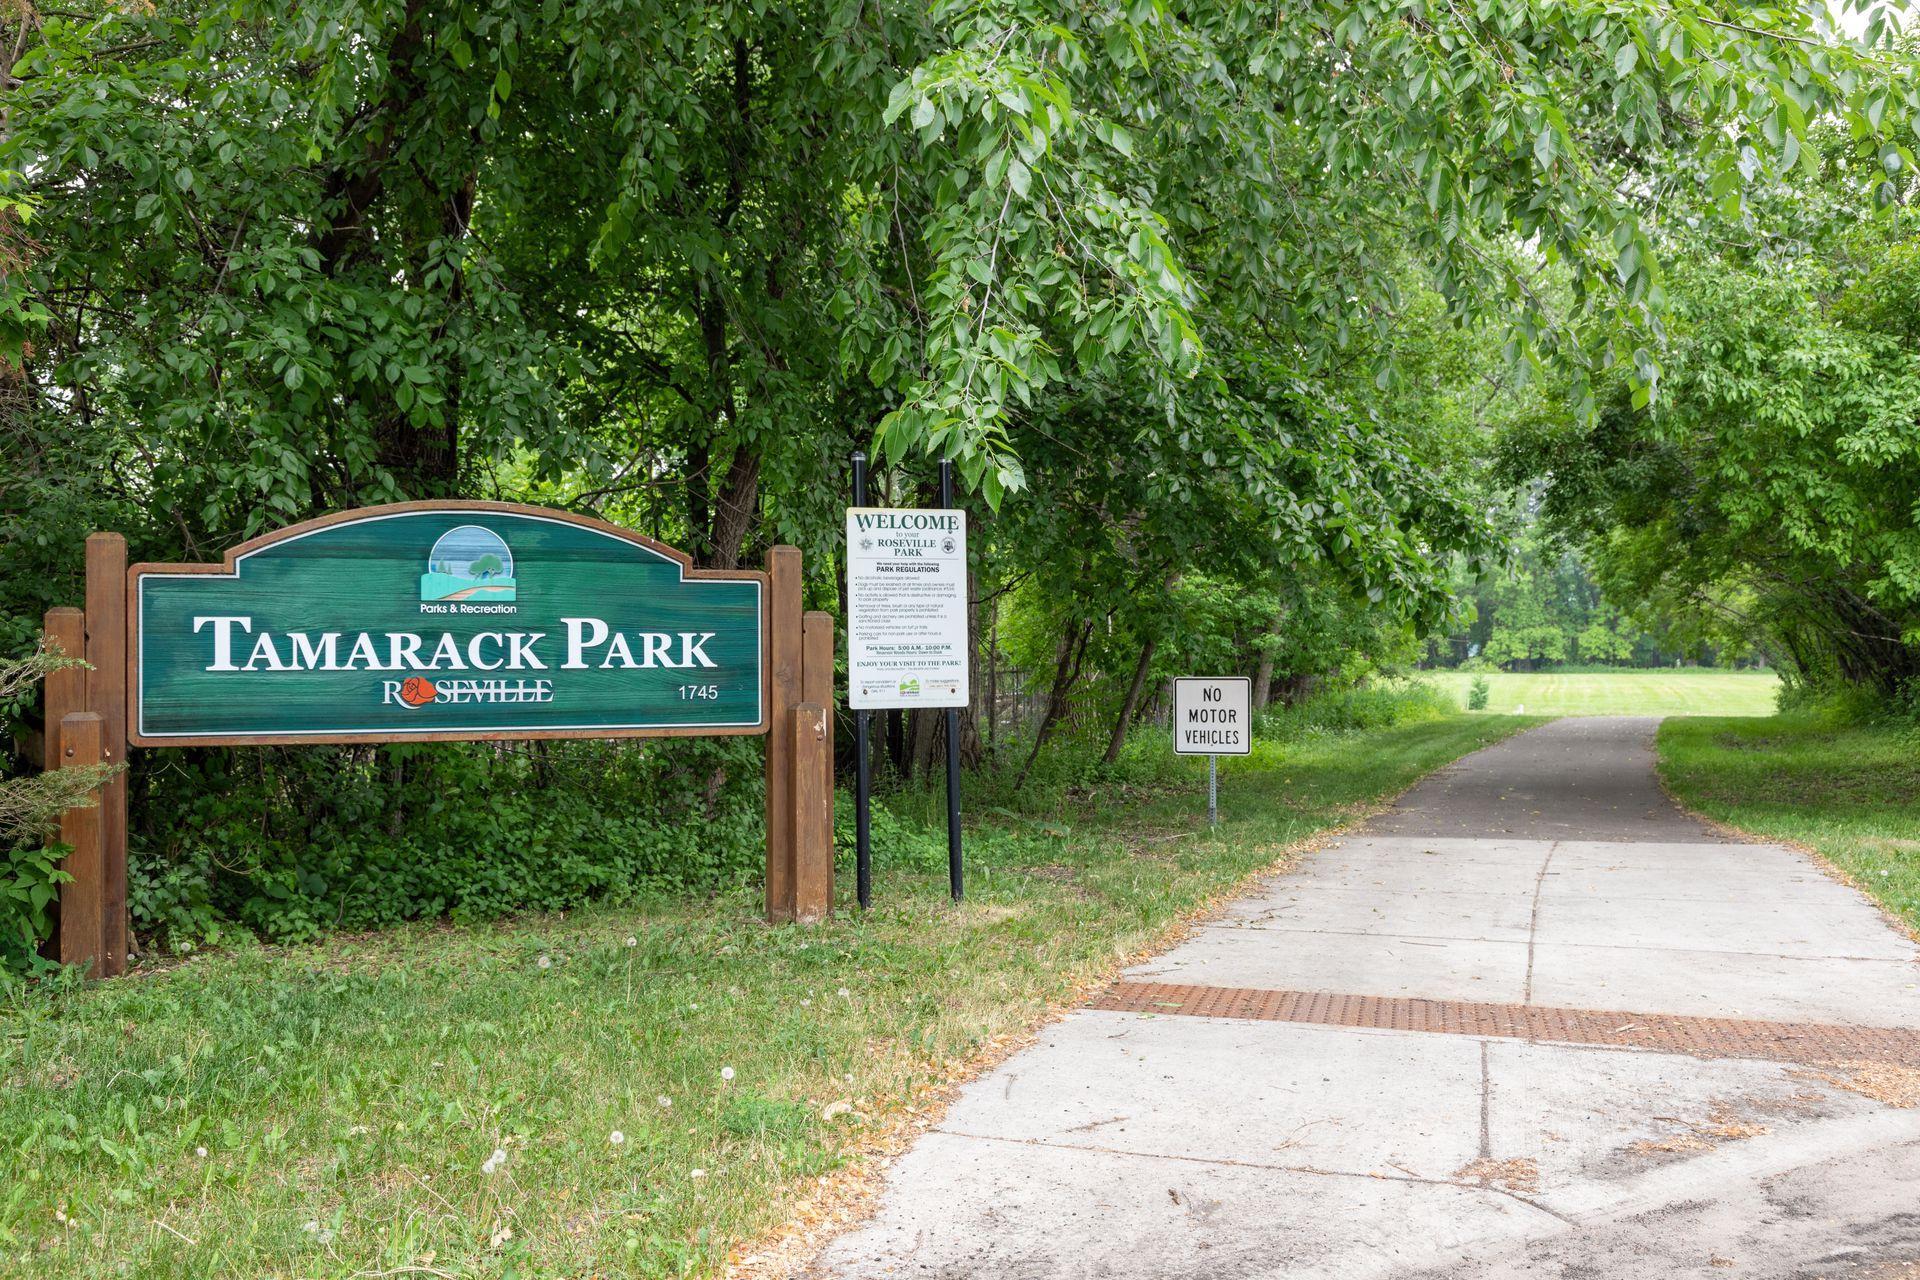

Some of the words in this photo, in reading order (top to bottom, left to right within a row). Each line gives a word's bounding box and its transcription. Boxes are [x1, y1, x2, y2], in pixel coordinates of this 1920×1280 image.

[855, 514, 959, 530] WELCOME
[896, 531, 902, 539] to
[904, 531, 919, 539] your
[878, 538, 936, 548] ROSEVILLE
[894, 548, 923, 556] PARK
[420, 604, 448, 614] Parks
[450, 604, 458, 614] &
[460, 604, 517, 614] Recreation
[193, 616, 548, 672] TAMARACK
[560, 617, 718, 669] PARK
[678, 686, 718, 700] 1745
[1204, 688, 1222, 702] NO
[1189, 709, 1236, 723] MOTOR
[1185, 730, 1239, 744] VEHICLES
